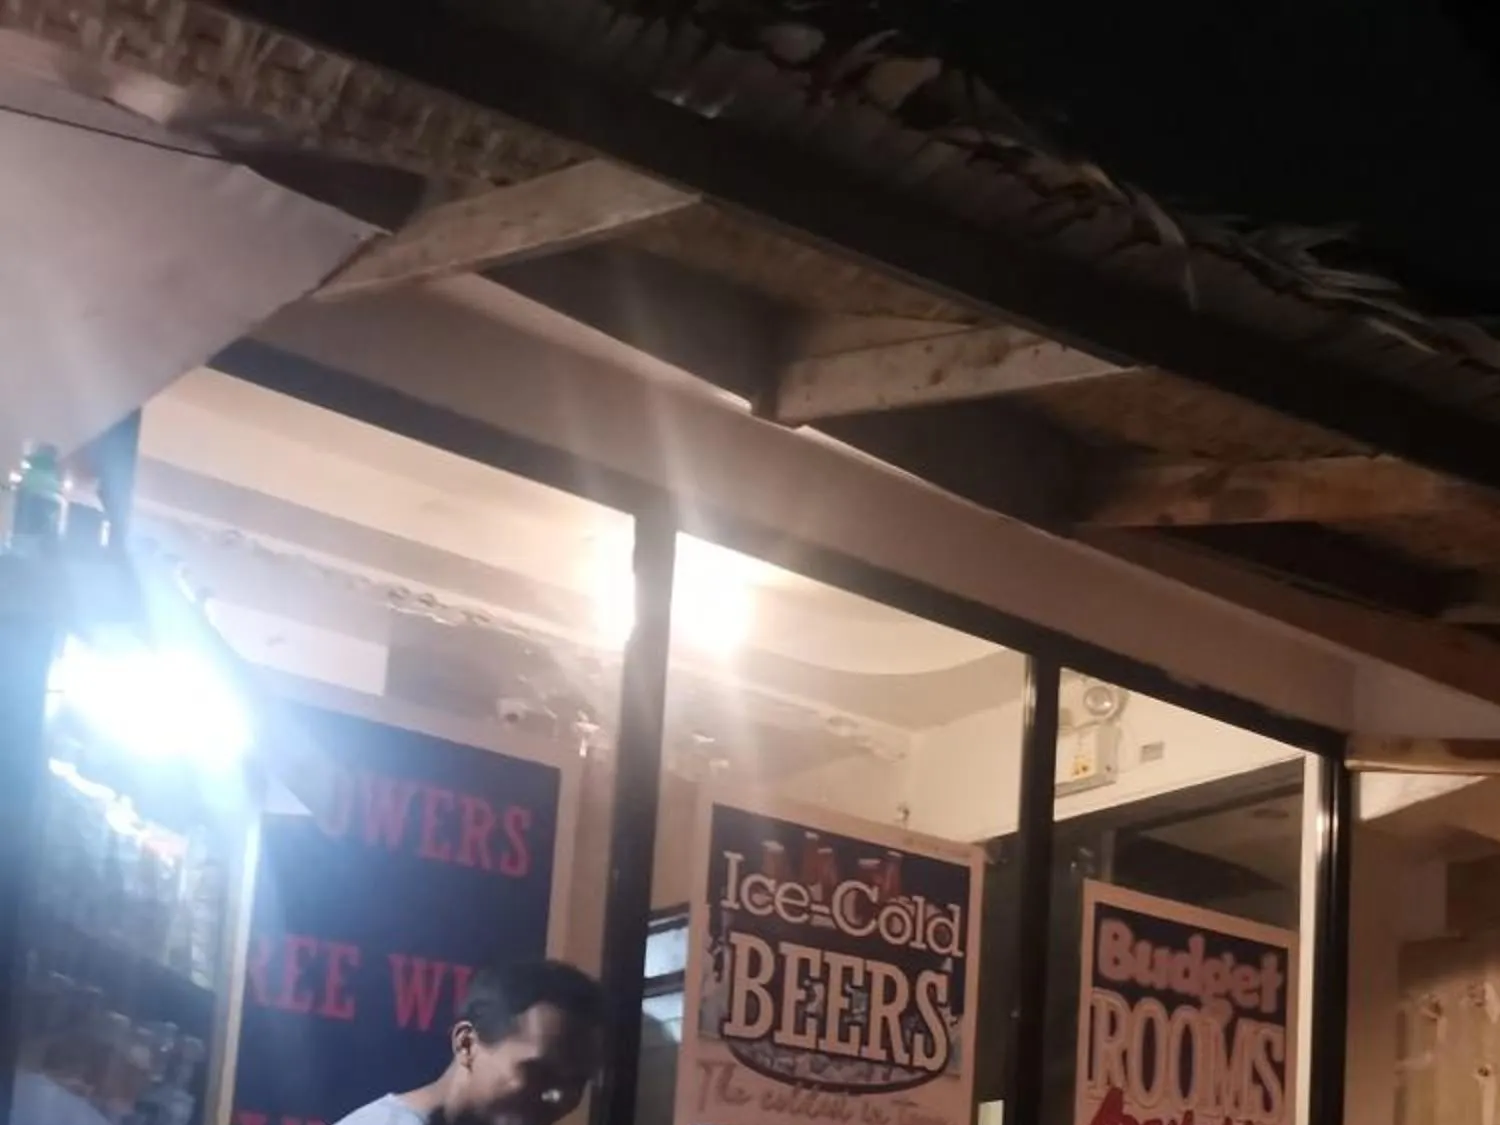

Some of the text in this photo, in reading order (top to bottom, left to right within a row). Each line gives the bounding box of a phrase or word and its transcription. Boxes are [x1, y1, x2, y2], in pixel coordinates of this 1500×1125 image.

[318, 768, 533, 876] OWERS
[722, 852, 964, 957] Ice-Cold
[246, 936, 361, 1021] REE
[724, 932, 950, 1072] BEERS
[1098, 918, 1284, 1020] Budget
[1088, 989, 1286, 1125] ROOMS
